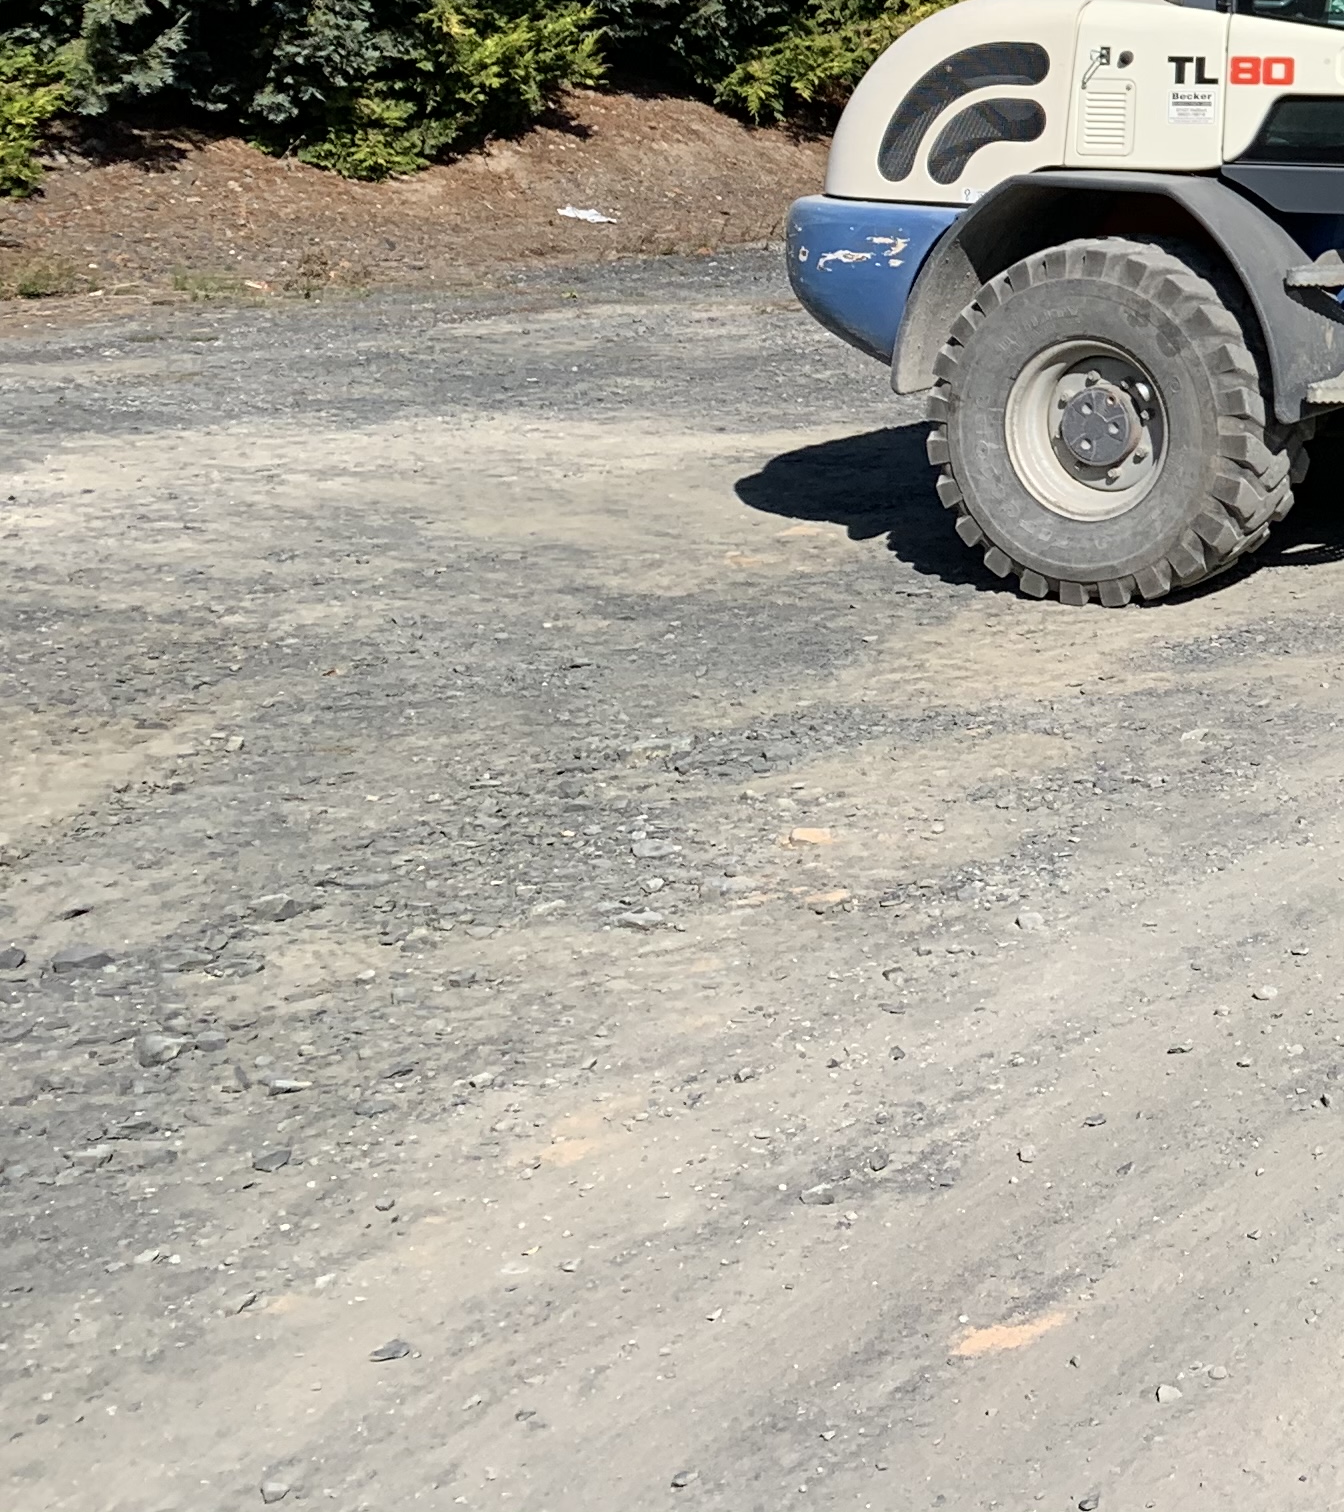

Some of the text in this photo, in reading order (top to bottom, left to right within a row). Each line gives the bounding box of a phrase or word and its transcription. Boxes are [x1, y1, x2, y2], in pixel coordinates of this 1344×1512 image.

[1167, 56, 1295, 85] TL 80
[1172, 91, 1213, 101] Becker
